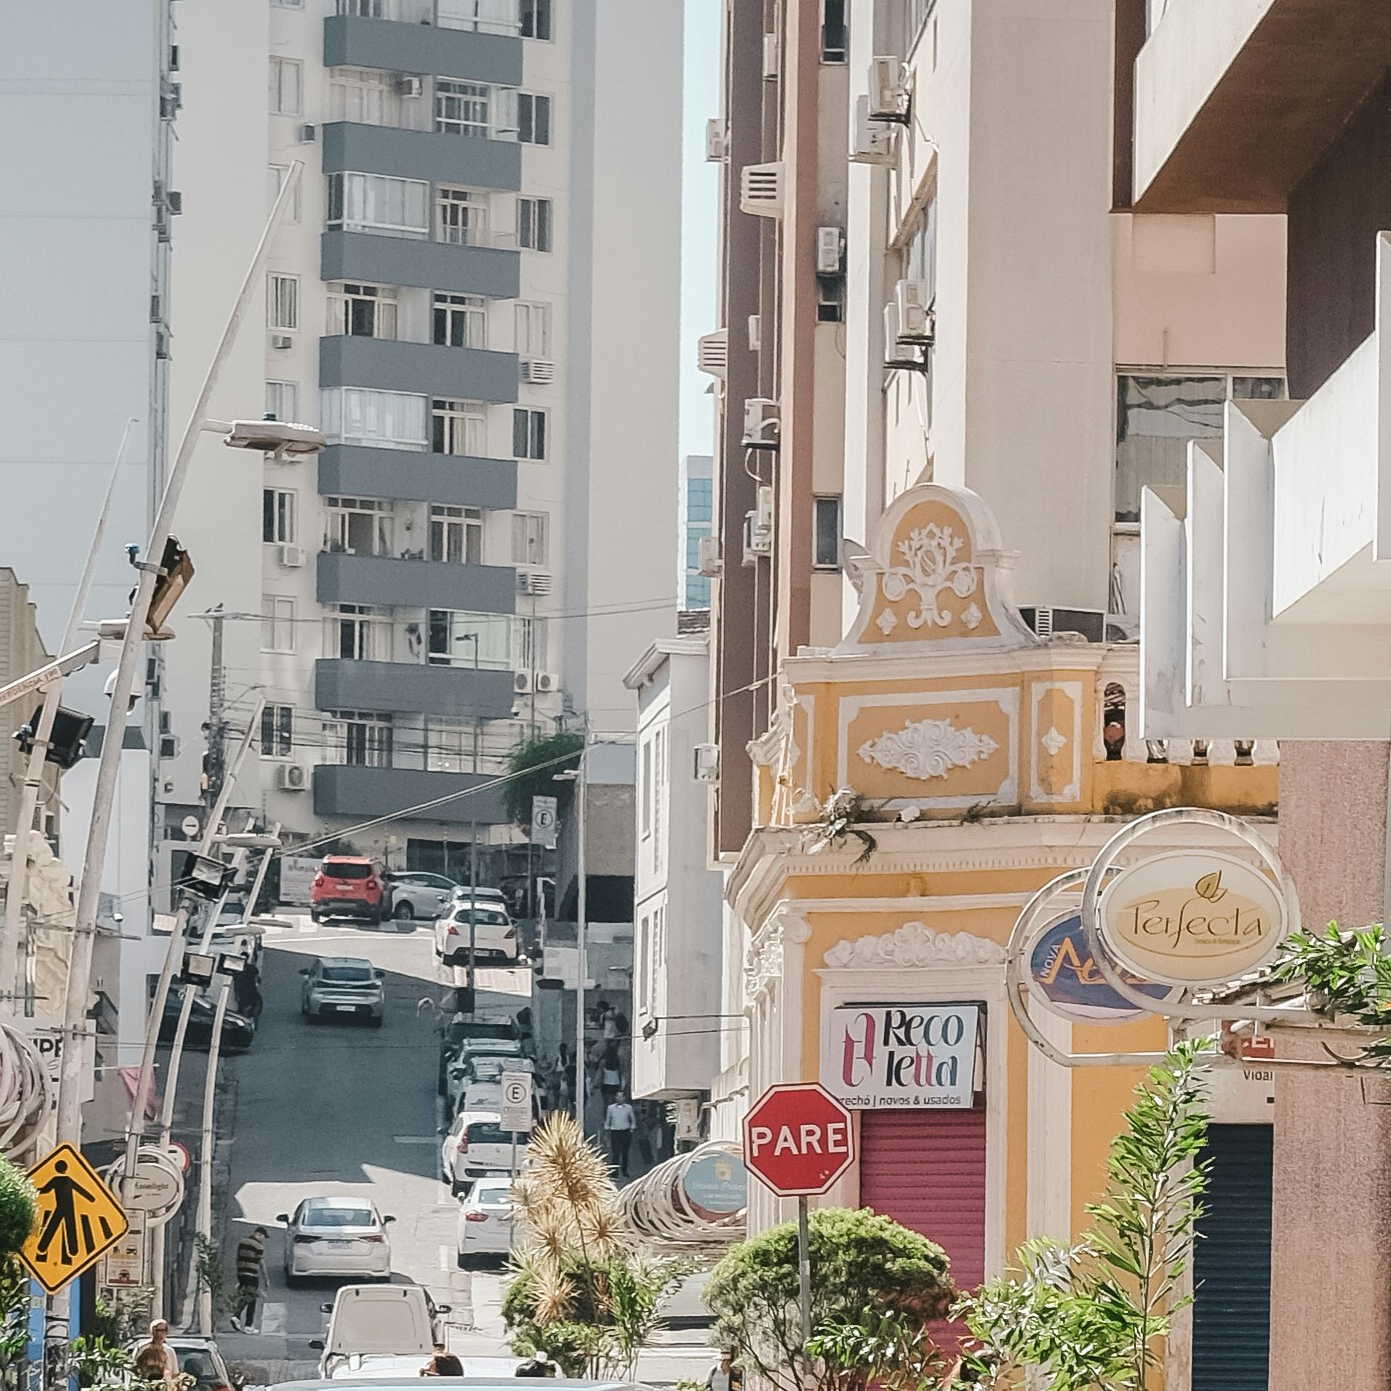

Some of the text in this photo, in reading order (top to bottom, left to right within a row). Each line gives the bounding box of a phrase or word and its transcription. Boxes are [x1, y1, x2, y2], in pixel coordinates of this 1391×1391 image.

[1125, 899, 1263, 949] Perfecta
[1040, 943, 1062, 978] NOVA
[512, 1086, 520, 1100] E
[838, 1094, 961, 1106] rechó novos & usados
[751, 1122, 848, 1157] PARE
